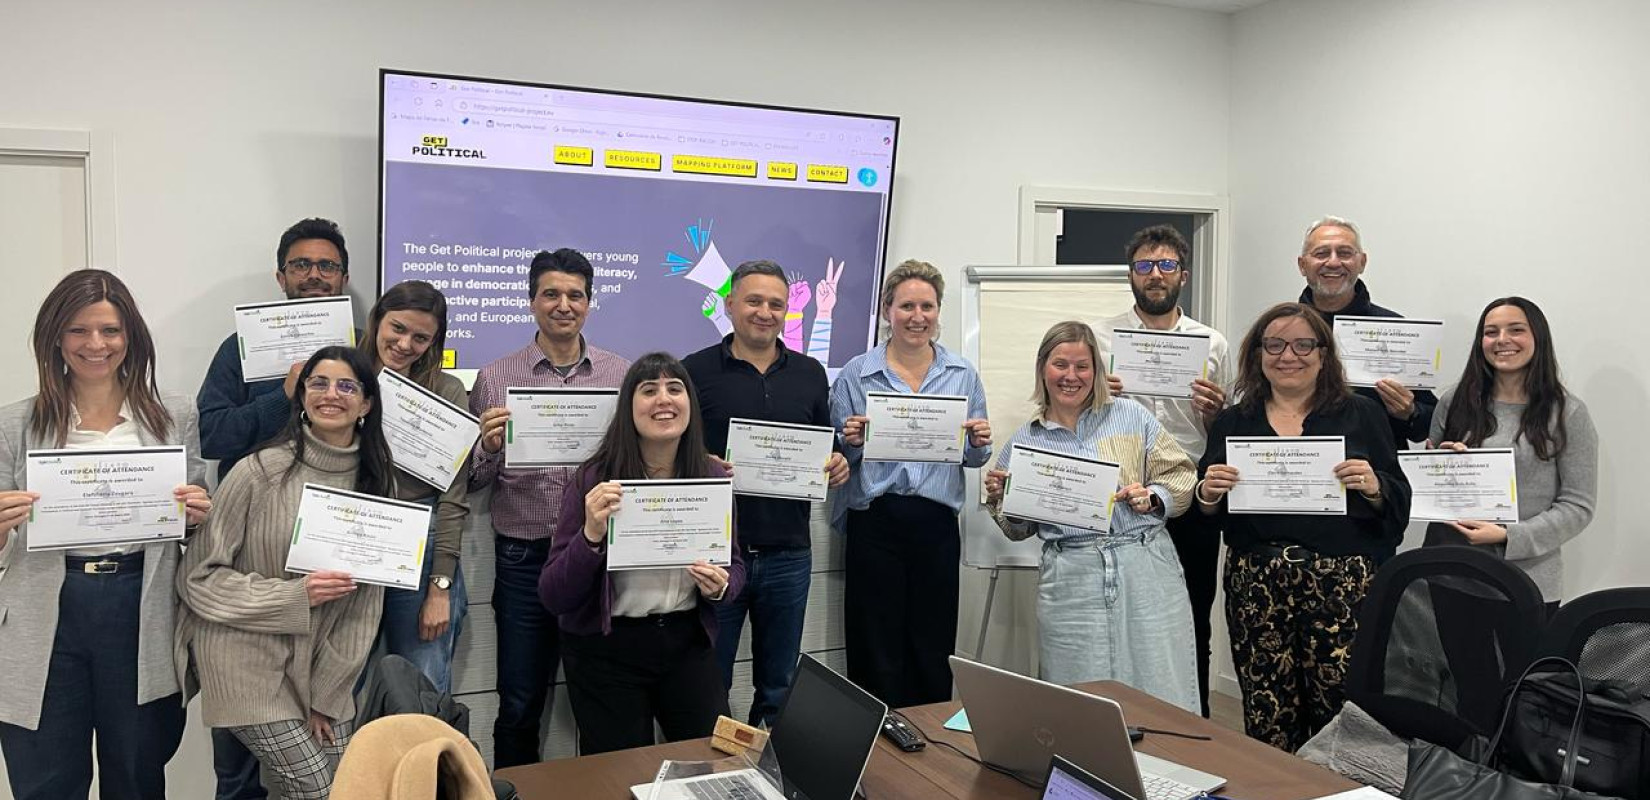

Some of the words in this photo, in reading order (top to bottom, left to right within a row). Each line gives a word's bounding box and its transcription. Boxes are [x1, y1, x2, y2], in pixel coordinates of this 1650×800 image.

[423, 136, 444, 144] GET
[412, 146, 487, 159] POLITICAL
[610, 154, 656, 164] RESOURCES
[676, 160, 711, 168] MAPPING
[713, 162, 752, 170] PLATFORM
[810, 168, 844, 178] CONTACT
[403, 243, 427, 254] The
[430, 244, 452, 255] Get
[454, 244, 500, 257] Political
[606, 252, 639, 264] young
[402, 261, 444, 273] people
[446, 262, 460, 272] to
[462, 262, 514, 274] enhance
[452, 278, 462, 288] in
[600, 283, 621, 293] and
[455, 312, 478, 322] and
[480, 312, 535, 324] European
[60, 468, 100, 476] CERTIFICATE
